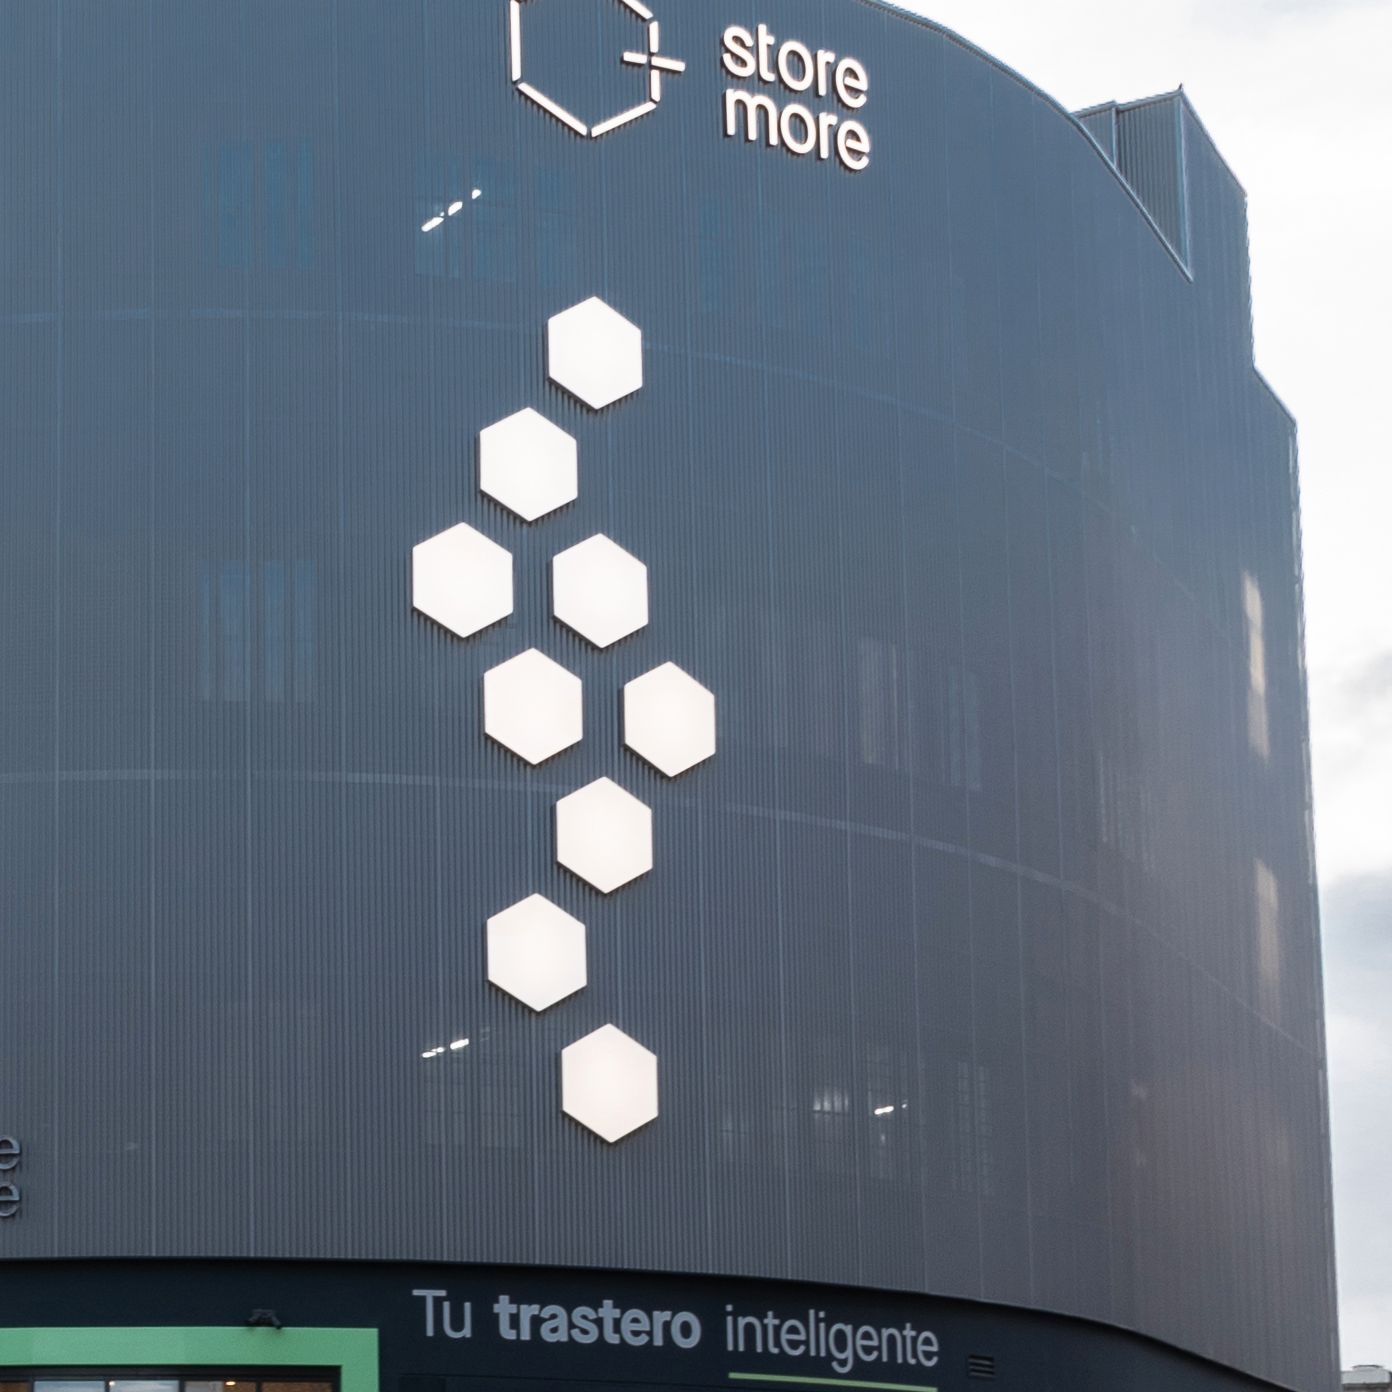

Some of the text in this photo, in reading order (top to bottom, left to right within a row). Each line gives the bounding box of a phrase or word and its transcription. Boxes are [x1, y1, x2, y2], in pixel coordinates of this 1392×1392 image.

[722, 23, 869, 109] store
[725, 88, 871, 171] more
[412, 1289, 939, 1374] Tu trastero inteligente
